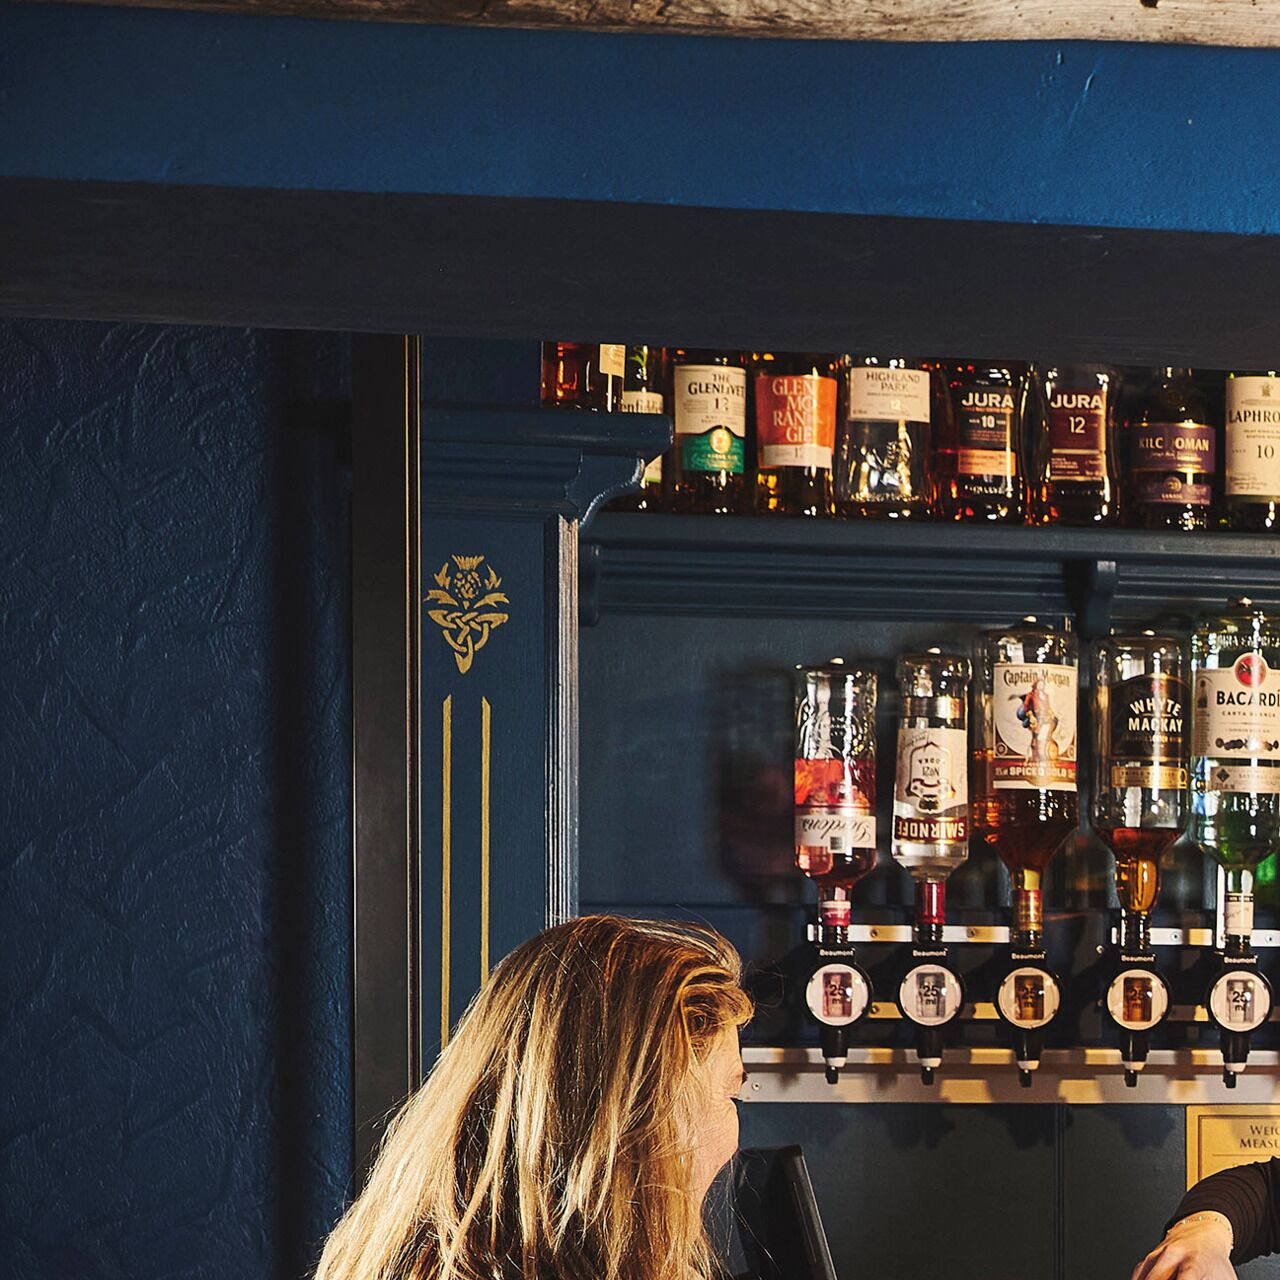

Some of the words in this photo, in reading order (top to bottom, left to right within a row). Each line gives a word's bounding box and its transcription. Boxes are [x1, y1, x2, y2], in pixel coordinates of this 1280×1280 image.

[866, 371, 920, 383] HIGHLAND
[688, 382, 744, 397] GLENLIVET
[772, 378, 815, 396] GLEN
[881, 382, 908, 392] PARK
[961, 392, 1014, 408] JURA
[1050, 394, 1103, 409] JURA
[981, 415, 995, 428] 10
[1069, 416, 1085, 434] 12
[1257, 444, 1275, 459] 10
[1004, 668, 1038, 687] Captain
[1041, 669, 1070, 687] Morgan
[1216, 689, 1280, 707] BACARDÍ
[1130, 697, 1181, 717] WHYTE
[1128, 717, 1183, 732] MACKAY
[923, 985, 939, 997] 25
